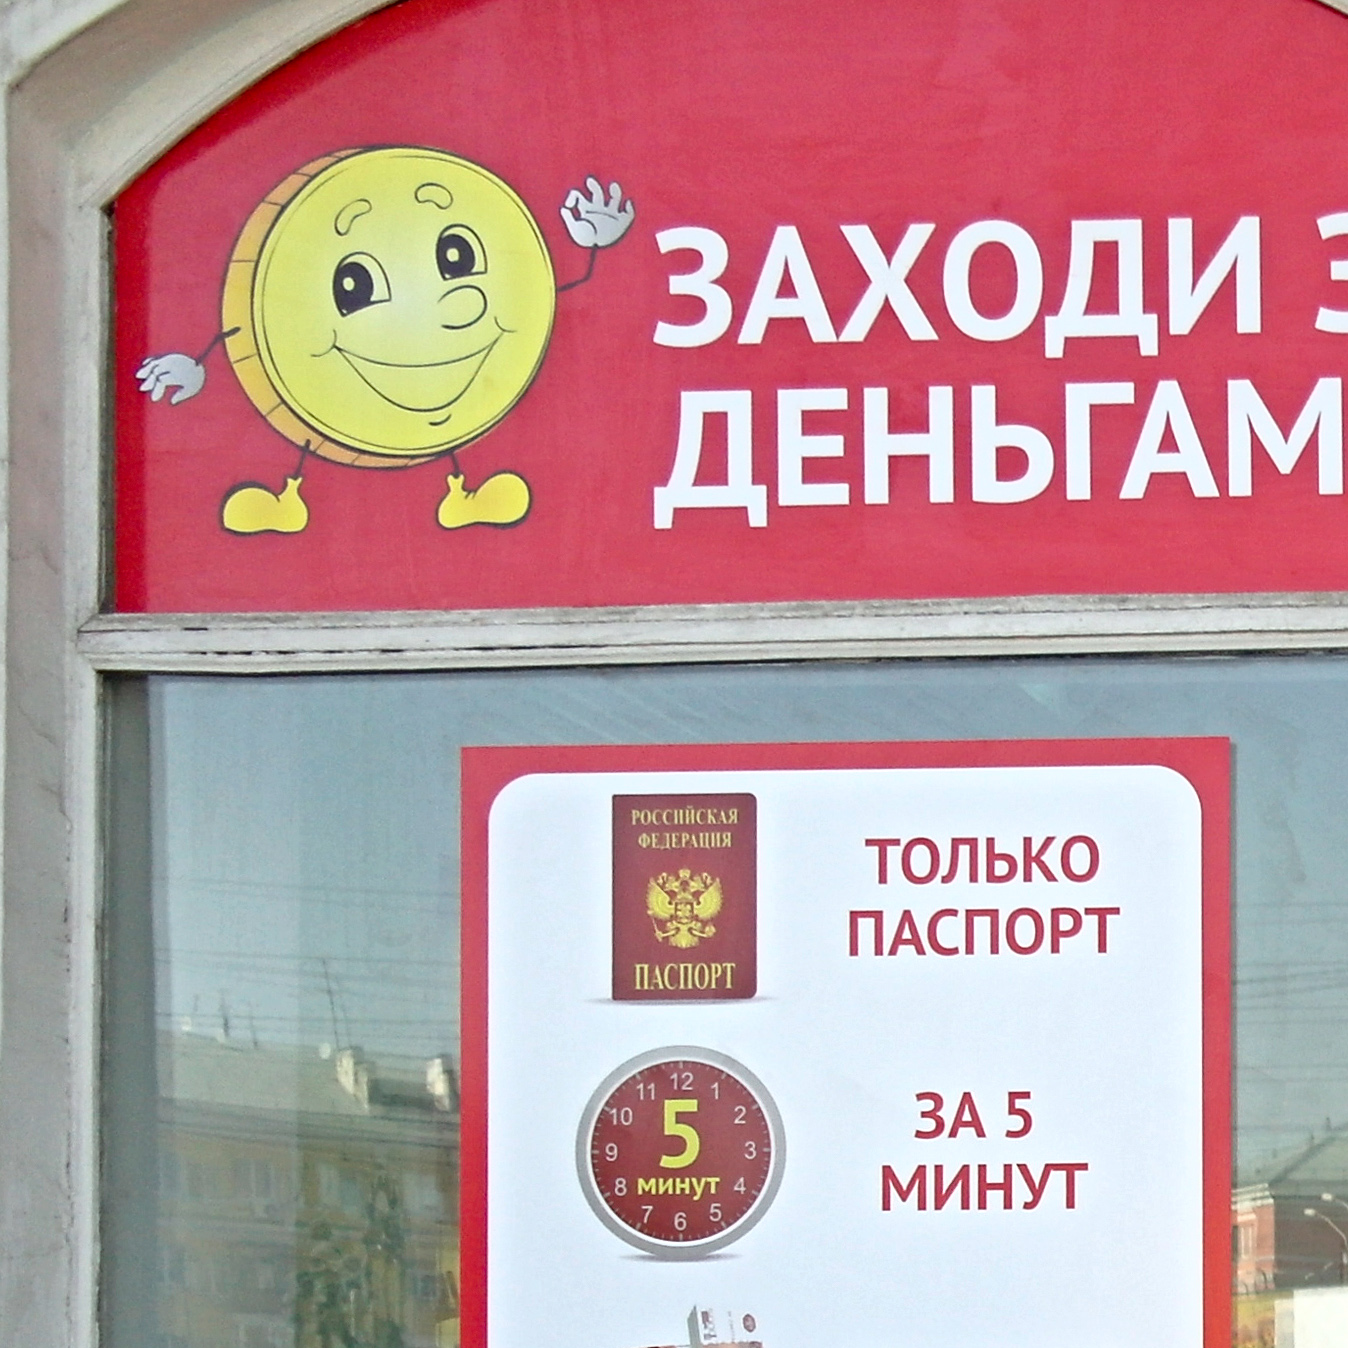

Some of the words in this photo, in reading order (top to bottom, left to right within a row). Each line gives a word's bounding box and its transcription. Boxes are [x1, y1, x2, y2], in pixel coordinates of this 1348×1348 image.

[653, 216, 1261, 358] ЗАХОДИ
[631, 805, 738, 826] РОССИЙСКАЯ
[638, 832, 732, 850] ФЕДЕРАЦИЯ
[865, 835, 1099, 884] ТОЛЬКО
[849, 907, 1120, 956] ПАСПОРТ
[636, 963, 735, 989] ПАСПОРТ
[671, 1072, 693, 1091] 12
[711, 1082, 718, 1099] 1
[637, 1083, 654, 1100] 11
[610, 1107, 632, 1125] 10
[734, 1106, 746, 1123] 2
[915, 1092, 986, 1139] ЗА
[1005, 1091, 1032, 1138] 5
[659, 1099, 700, 1169] 5
[606, 1143, 617, 1161] 9
[745, 1141, 756, 1159] 3
[615, 1178, 626, 1196] 8
[638, 1178, 720, 1200] минут
[734, 1177, 746, 1194] 4
[882, 1163, 1088, 1211] МИНУТ
[642, 1206, 653, 1223] 7
[674, 1212, 686, 1230] 6
[710, 1203, 721, 1221] 5
